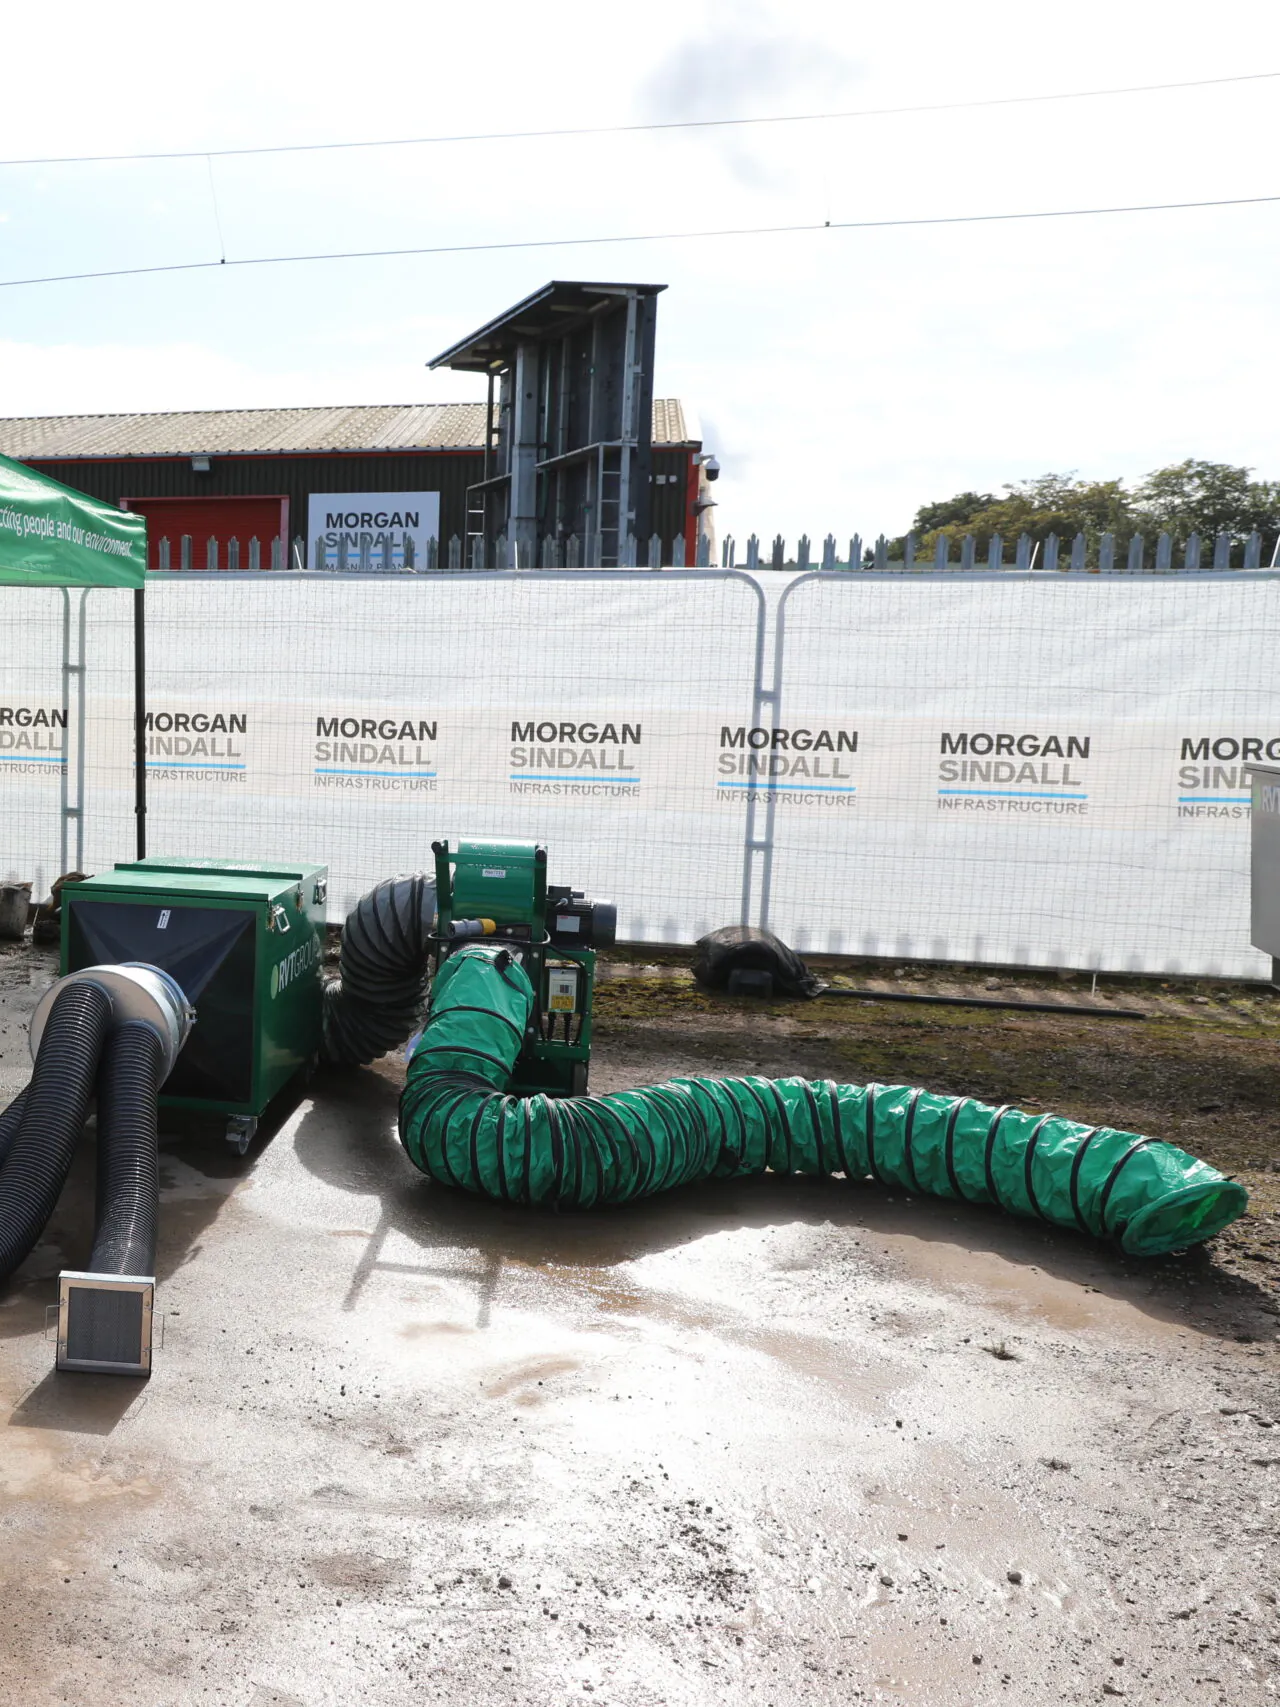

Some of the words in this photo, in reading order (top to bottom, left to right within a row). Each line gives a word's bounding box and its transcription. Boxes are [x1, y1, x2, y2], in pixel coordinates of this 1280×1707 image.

[325, 511, 420, 529] MORGAN
[23, 513, 55, 541] people
[57, 519, 72, 541] and
[72, 526, 85, 546] our
[85, 529, 134, 557] environment
[316, 716, 438, 741] MORGAN
[510, 721, 642, 745] MORGAN
[719, 726, 859, 753] MORGAN
[314, 741, 432, 765] SINDALL
[939, 732, 1091, 759] MORGAN
[509, 747, 635, 770] SINDALL
[717, 753, 851, 780] SINDALL
[313, 776, 438, 791] INFRASTRUCTURE
[937, 760, 1083, 786] SINDALL
[509, 782, 641, 798] INFRASTRUCTURE
[716, 788, 857, 807] INFRASTRUCTURE
[937, 798, 1090, 816] INFRASTRUCTURE
